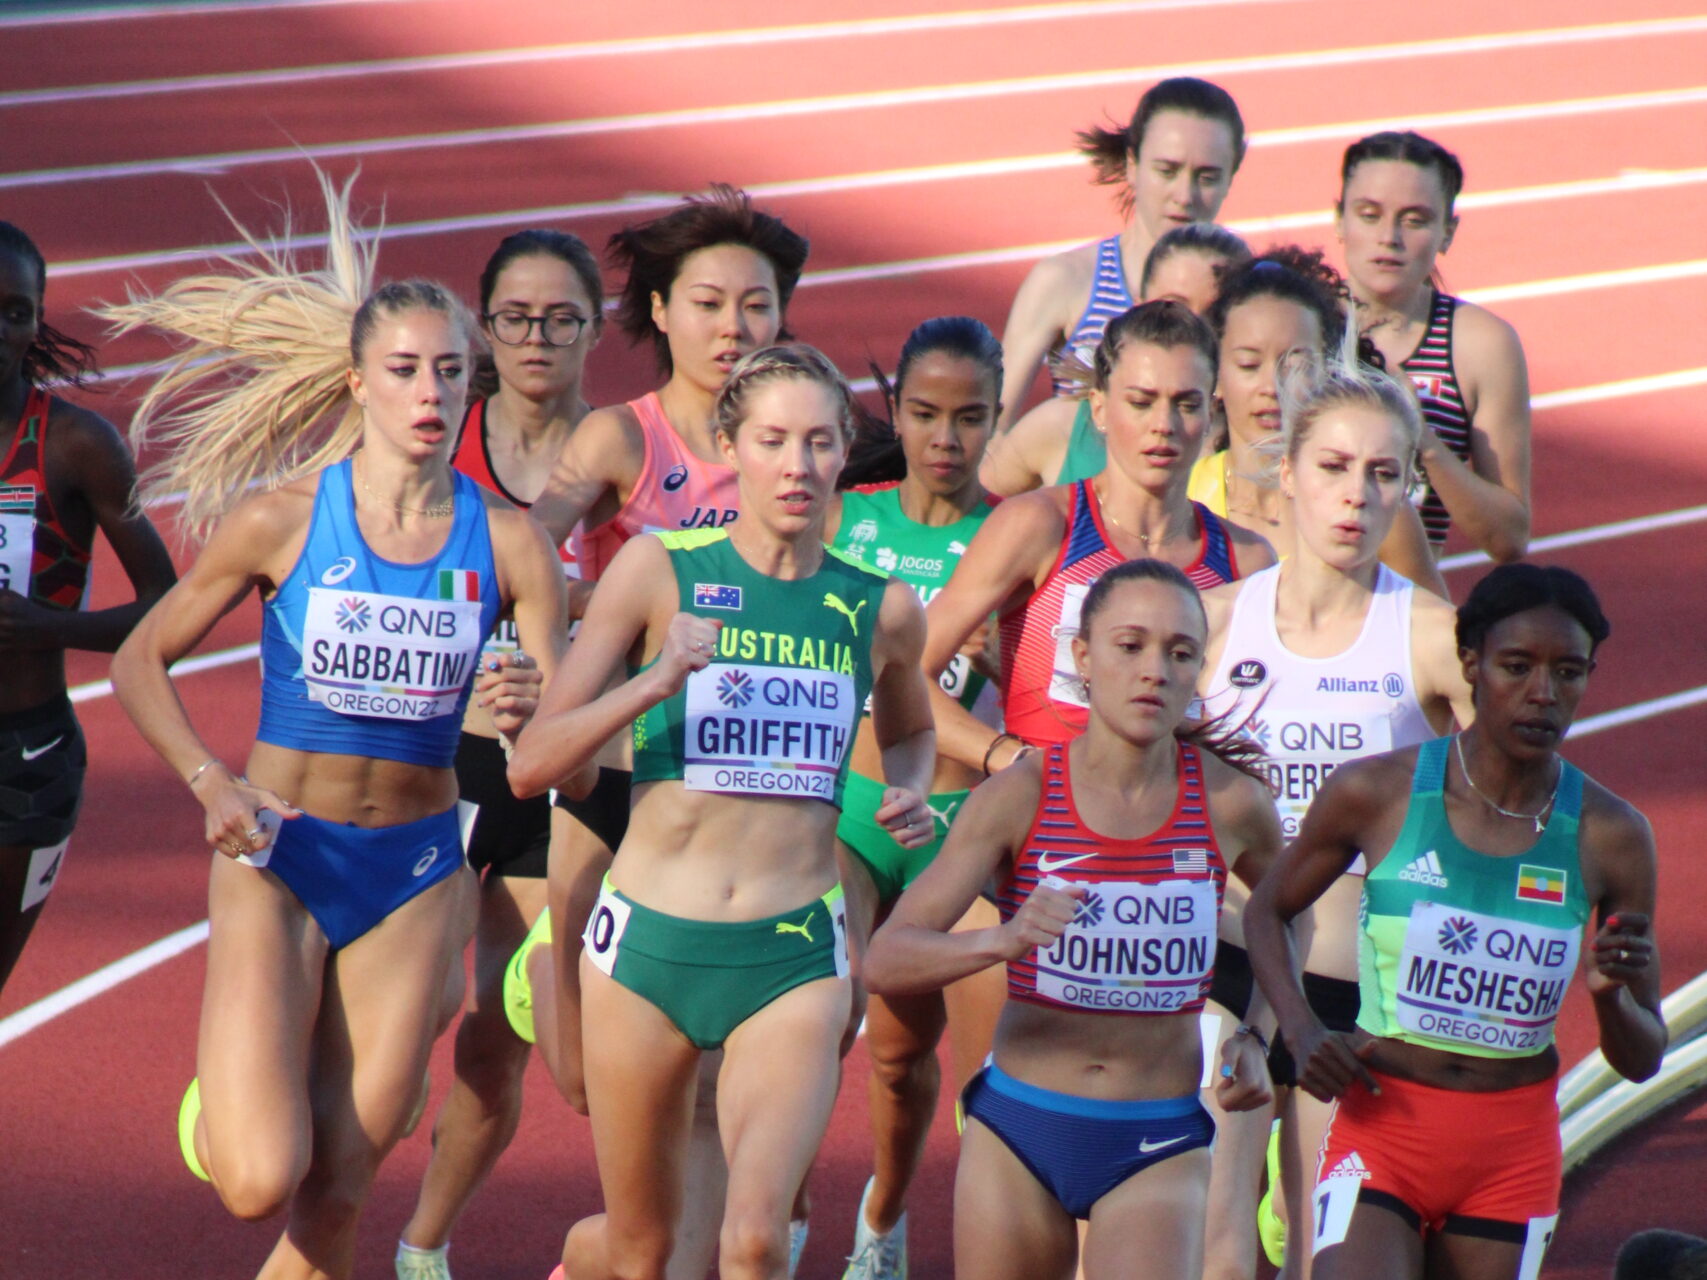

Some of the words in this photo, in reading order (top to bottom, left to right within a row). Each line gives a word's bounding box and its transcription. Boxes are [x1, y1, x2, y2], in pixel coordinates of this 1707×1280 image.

[898, 555, 944, 571] JOGOS
[379, 605, 456, 638] QNB
[312, 639, 467, 687] SABBATINI
[713, 626, 854, 677] USTRALIA
[763, 676, 839, 711] QNB
[1316, 676, 1379, 693] Allianz
[327, 691, 440, 718] OREGON22
[697, 716, 846, 764] GRIFFITH
[1280, 721, 1363, 752] QNB
[714, 769, 830, 795] OREGON22
[1398, 869, 1448, 889] adidas
[1113, 895, 1195, 926] QNB
[1048, 934, 1207, 976] JOHNSON
[1485, 929, 1568, 968] QNB
[1063, 984, 1187, 1009] OREGON22
[1406, 955, 1565, 1017] MESHESHA
[1418, 1013, 1538, 1049] OREGON22
[1328, 1168, 1372, 1180] adidas
